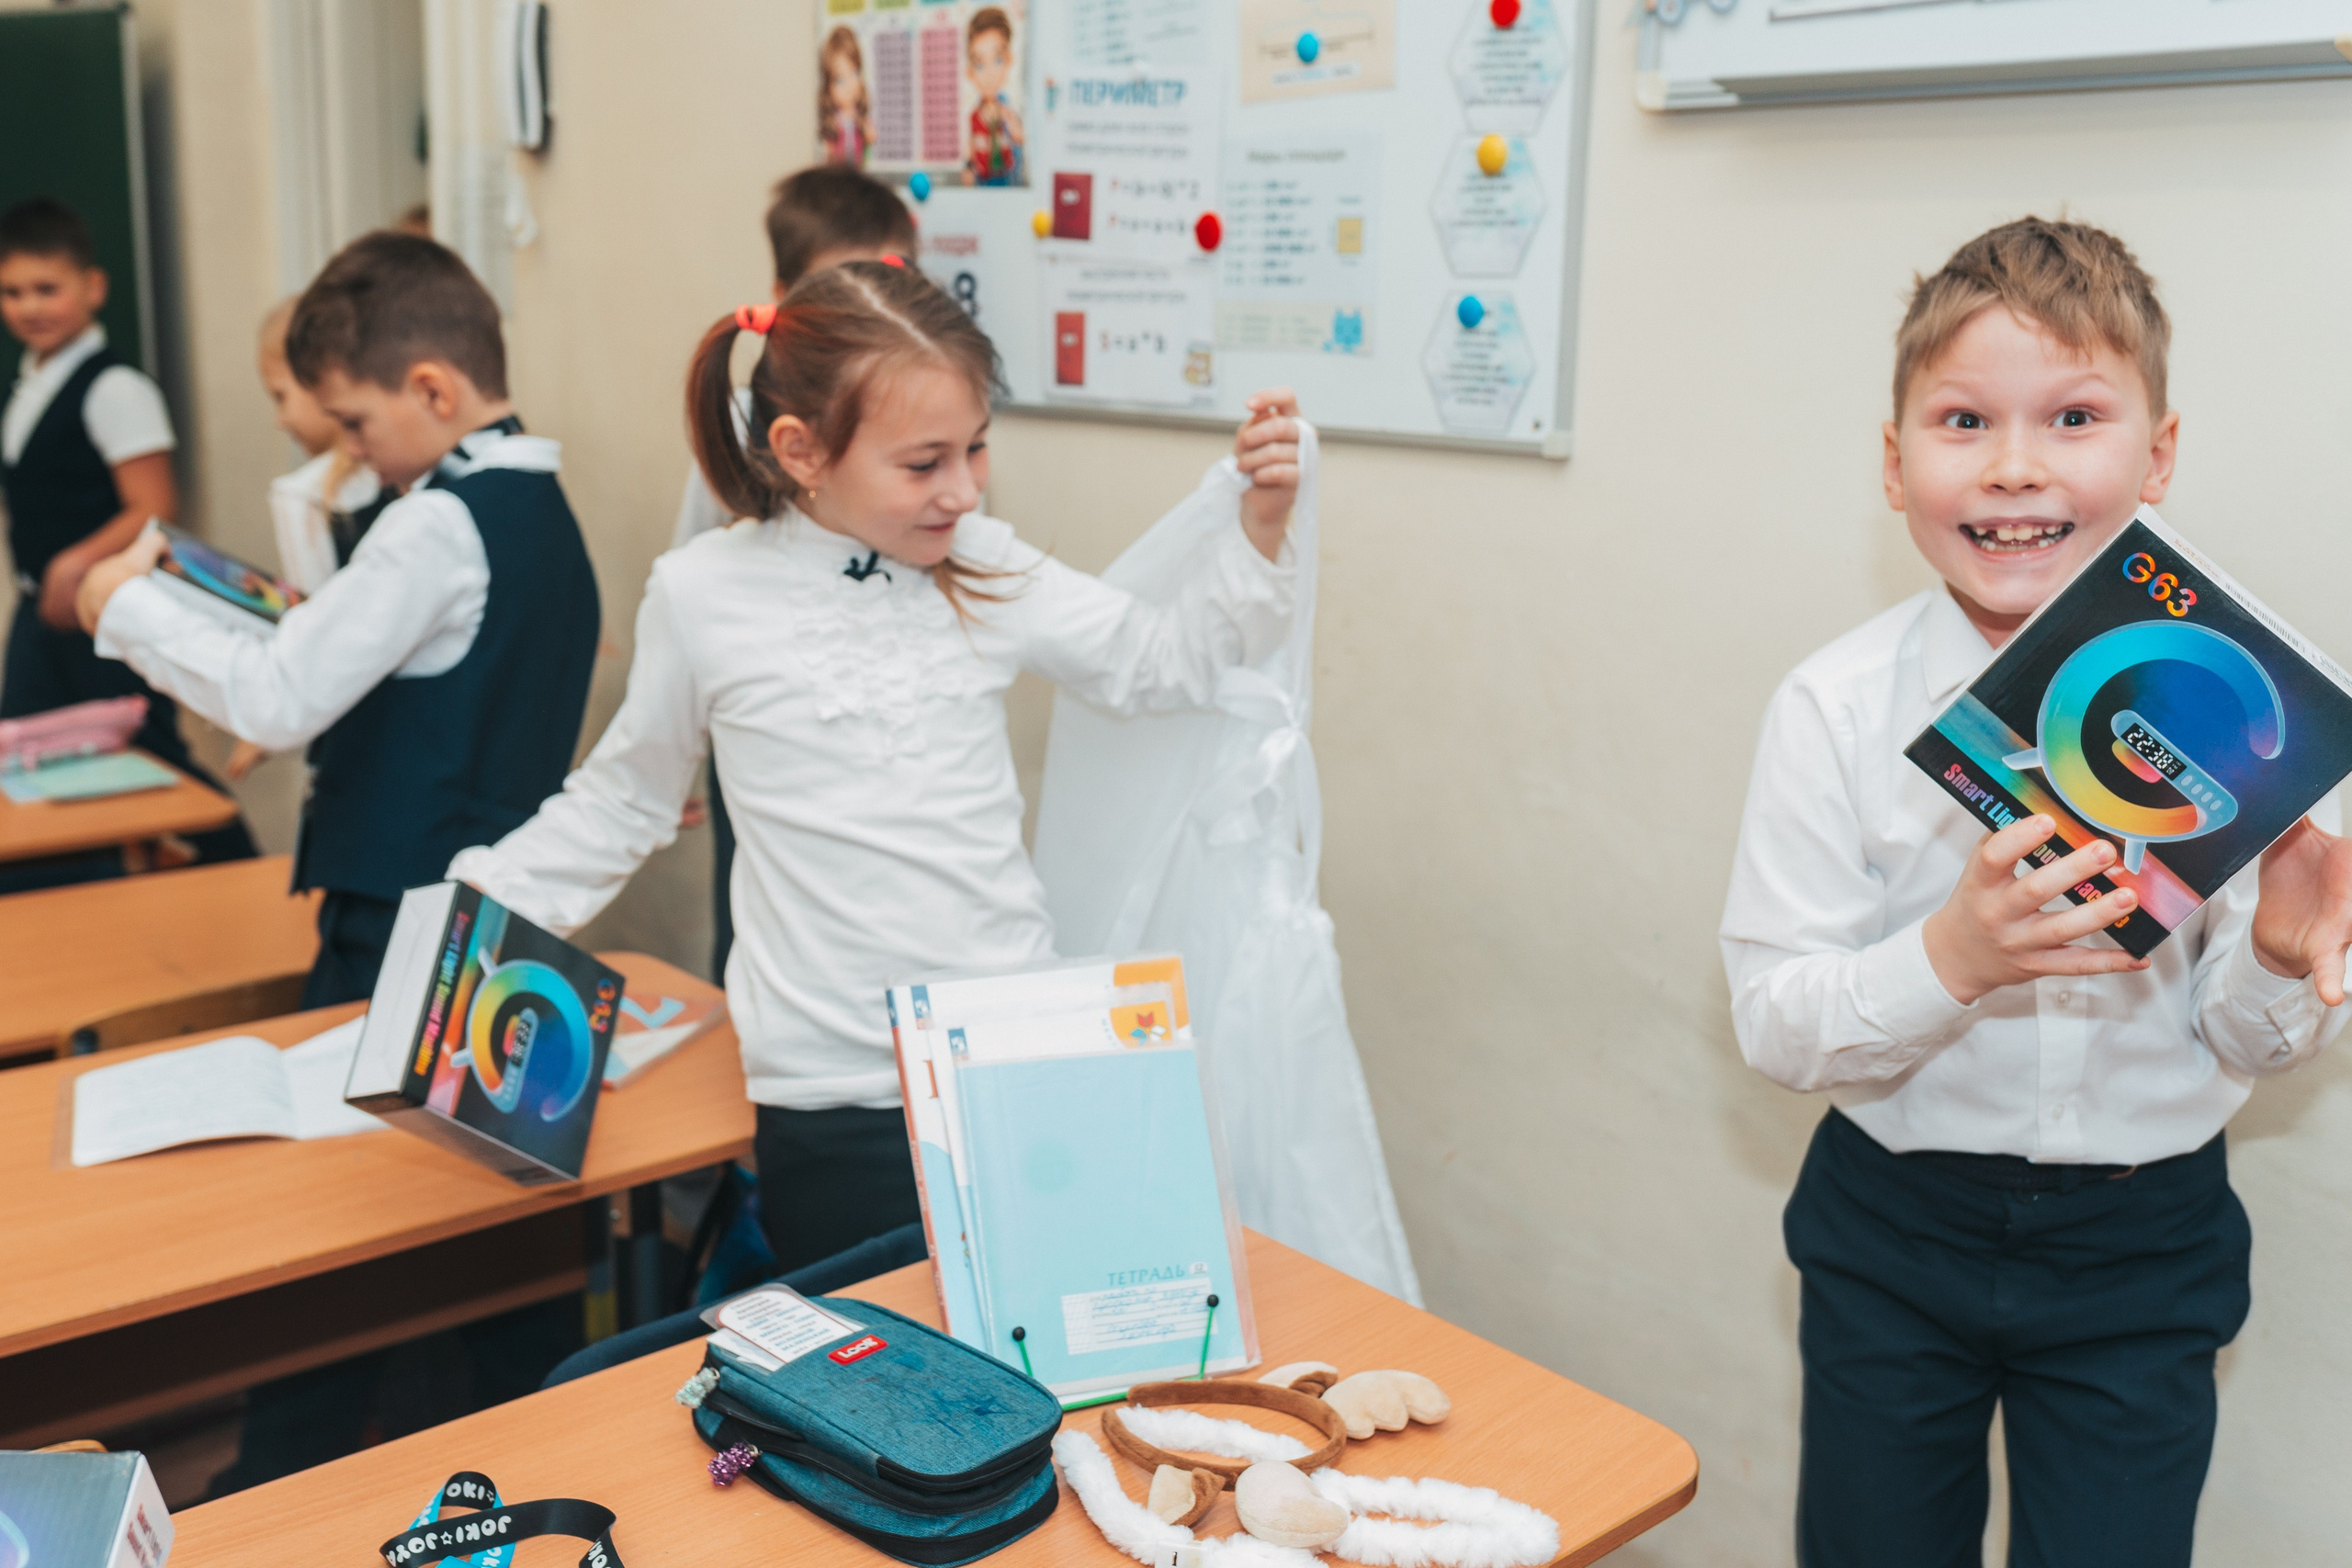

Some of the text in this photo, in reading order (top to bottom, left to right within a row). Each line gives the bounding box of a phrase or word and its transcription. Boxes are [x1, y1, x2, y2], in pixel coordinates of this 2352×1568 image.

[2122, 552, 2198, 617] G63
[2127, 728, 2174, 770] 22:38
[1944, 763, 2021, 830] Smart Lig
[1107, 1264, 1185, 1286] ТЕТРАДЬ
[386, 1515, 512, 1567] JOKI JOYA
